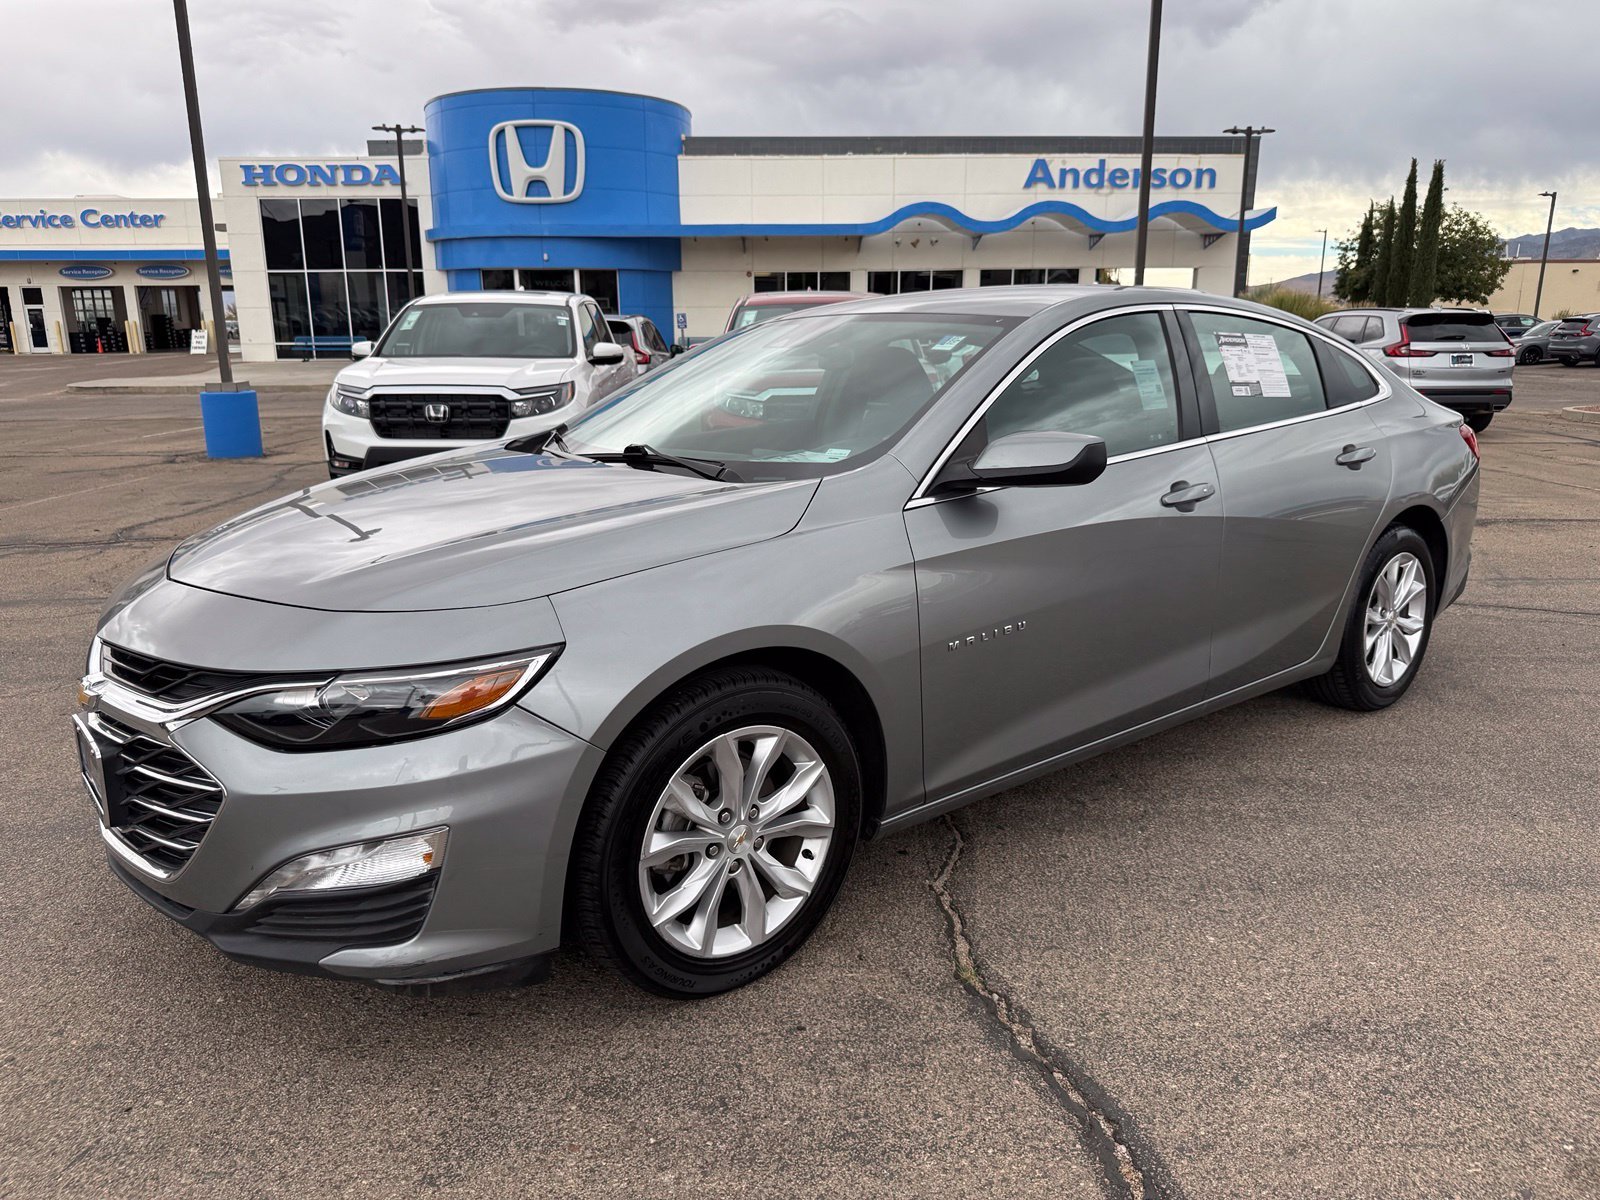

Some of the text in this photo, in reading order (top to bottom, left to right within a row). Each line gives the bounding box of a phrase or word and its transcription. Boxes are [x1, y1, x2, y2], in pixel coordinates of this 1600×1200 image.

[239, 163, 403, 187] HONDA
[1023, 159, 1217, 189] Anderson
[0, 208, 165, 228] ervice Center
[947, 620, 1027, 652] MALIBU
